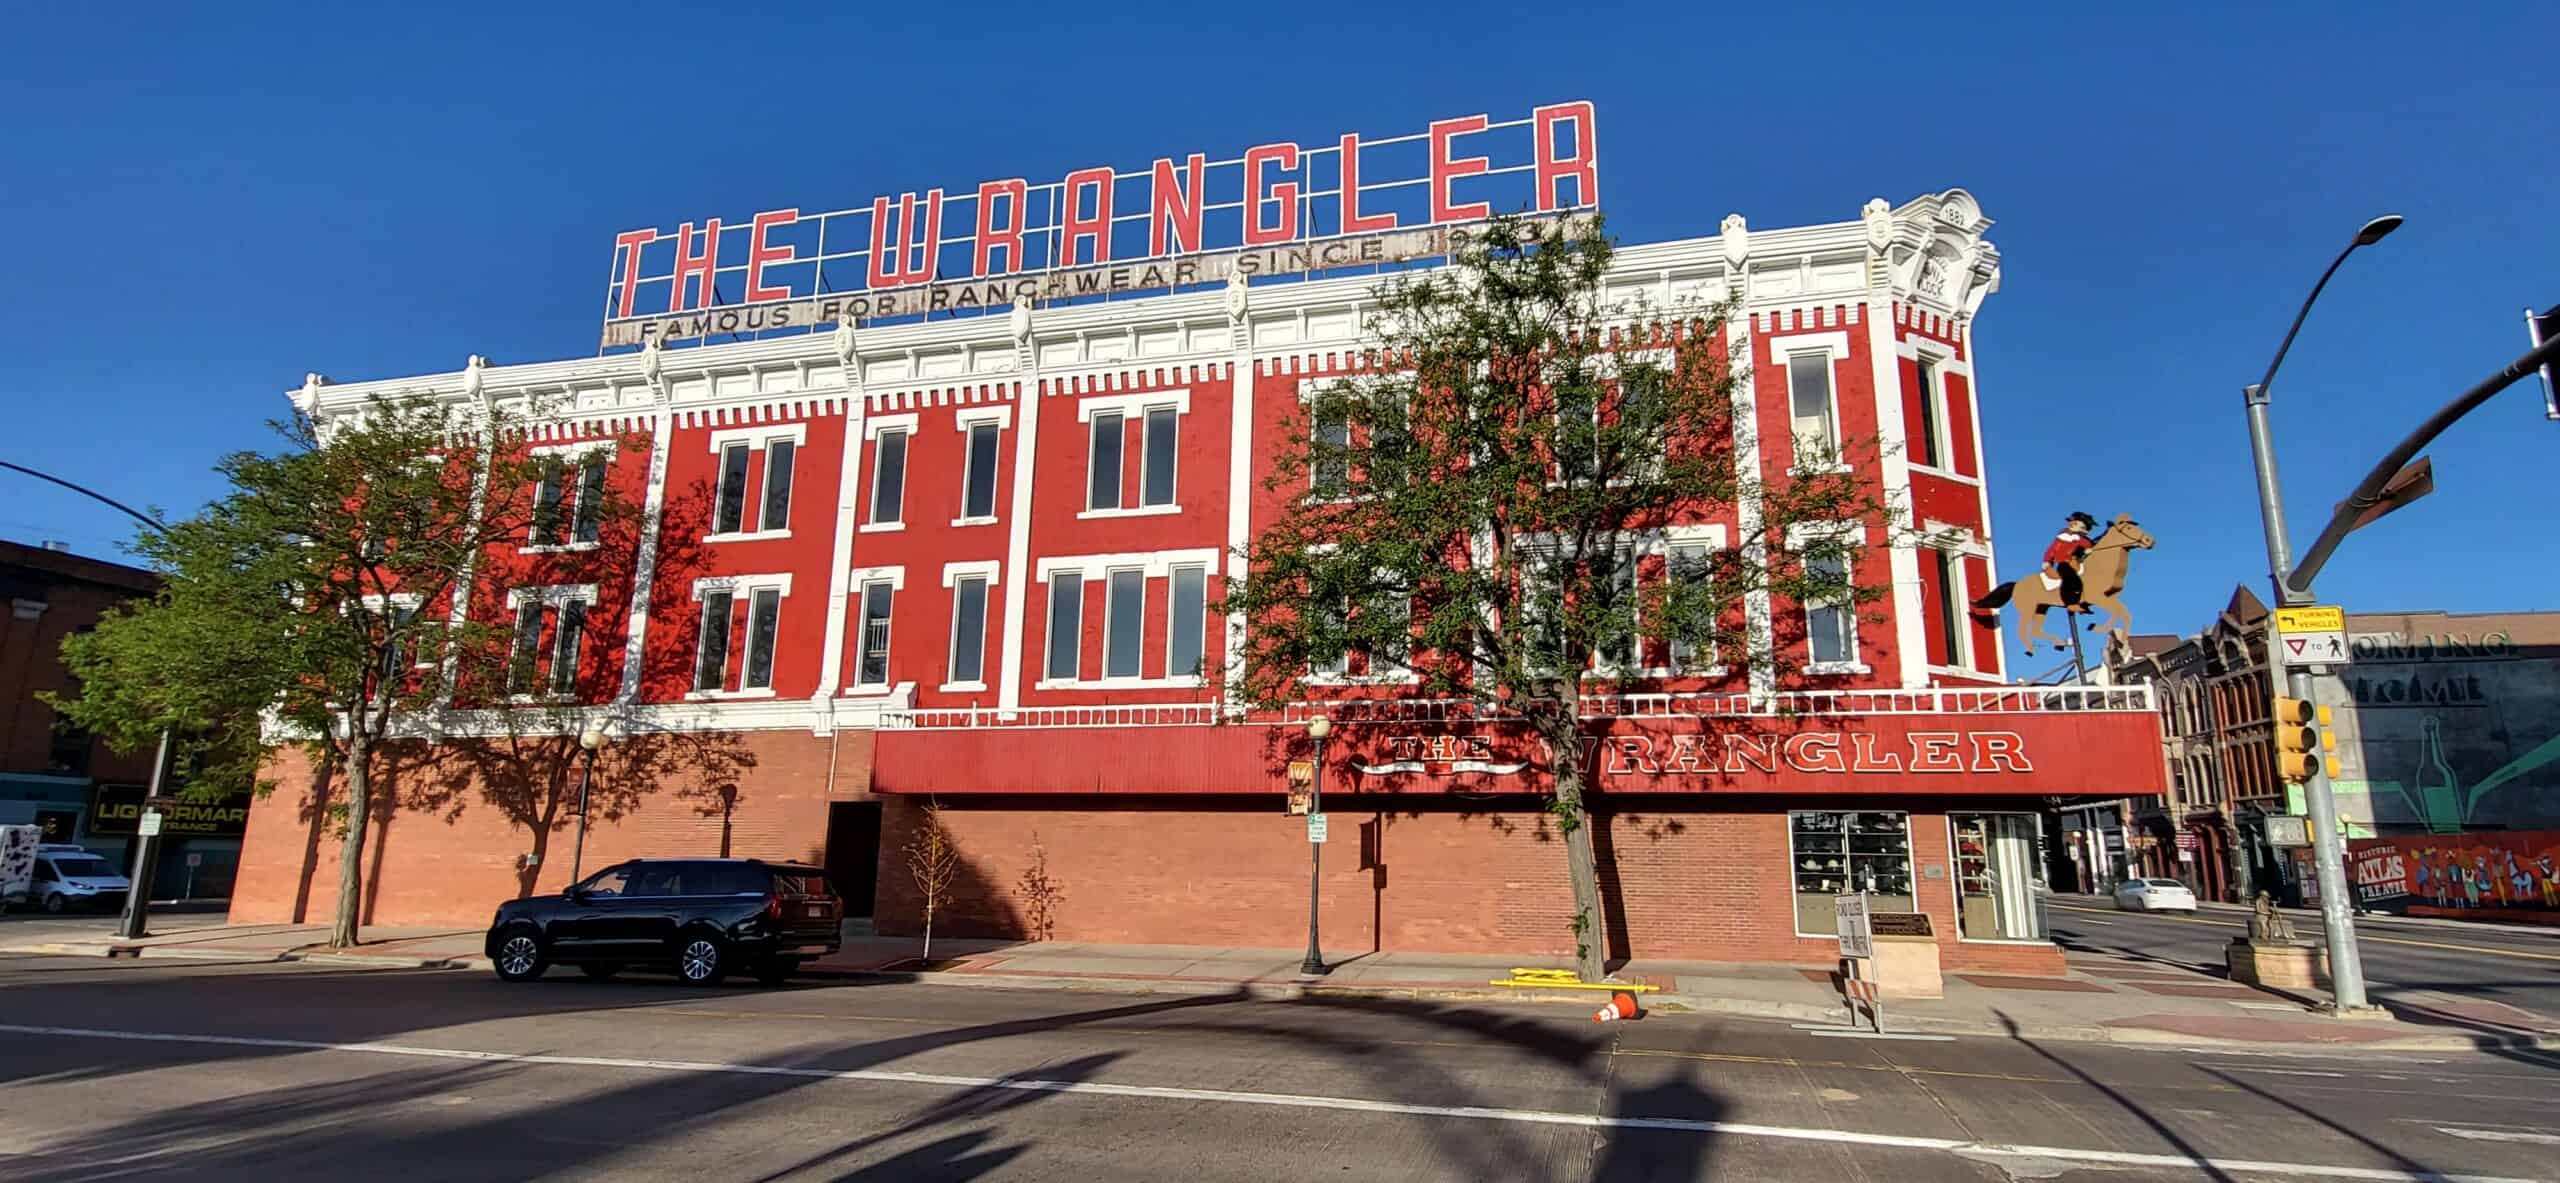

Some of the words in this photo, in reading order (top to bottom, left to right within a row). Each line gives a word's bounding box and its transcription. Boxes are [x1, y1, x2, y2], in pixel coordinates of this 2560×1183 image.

[616, 208, 799, 318] THE
[867, 100, 1599, 290] WRANGLER
[640, 305, 790, 341] FAMOUS
[821, 296, 898, 321] FOR
[1238, 238, 1384, 274] SINCE
[1427, 221, 1540, 254] 193
[2298, 620, 2340, 628] VEHICLES
[2351, 631, 2513, 659] OMING
[1388, 735, 1491, 761] THE
[98, 802, 249, 822] LIQORMAR
[2358, 855, 2406, 885] ATLAS
[2359, 880, 2408, 897] THEATRE
